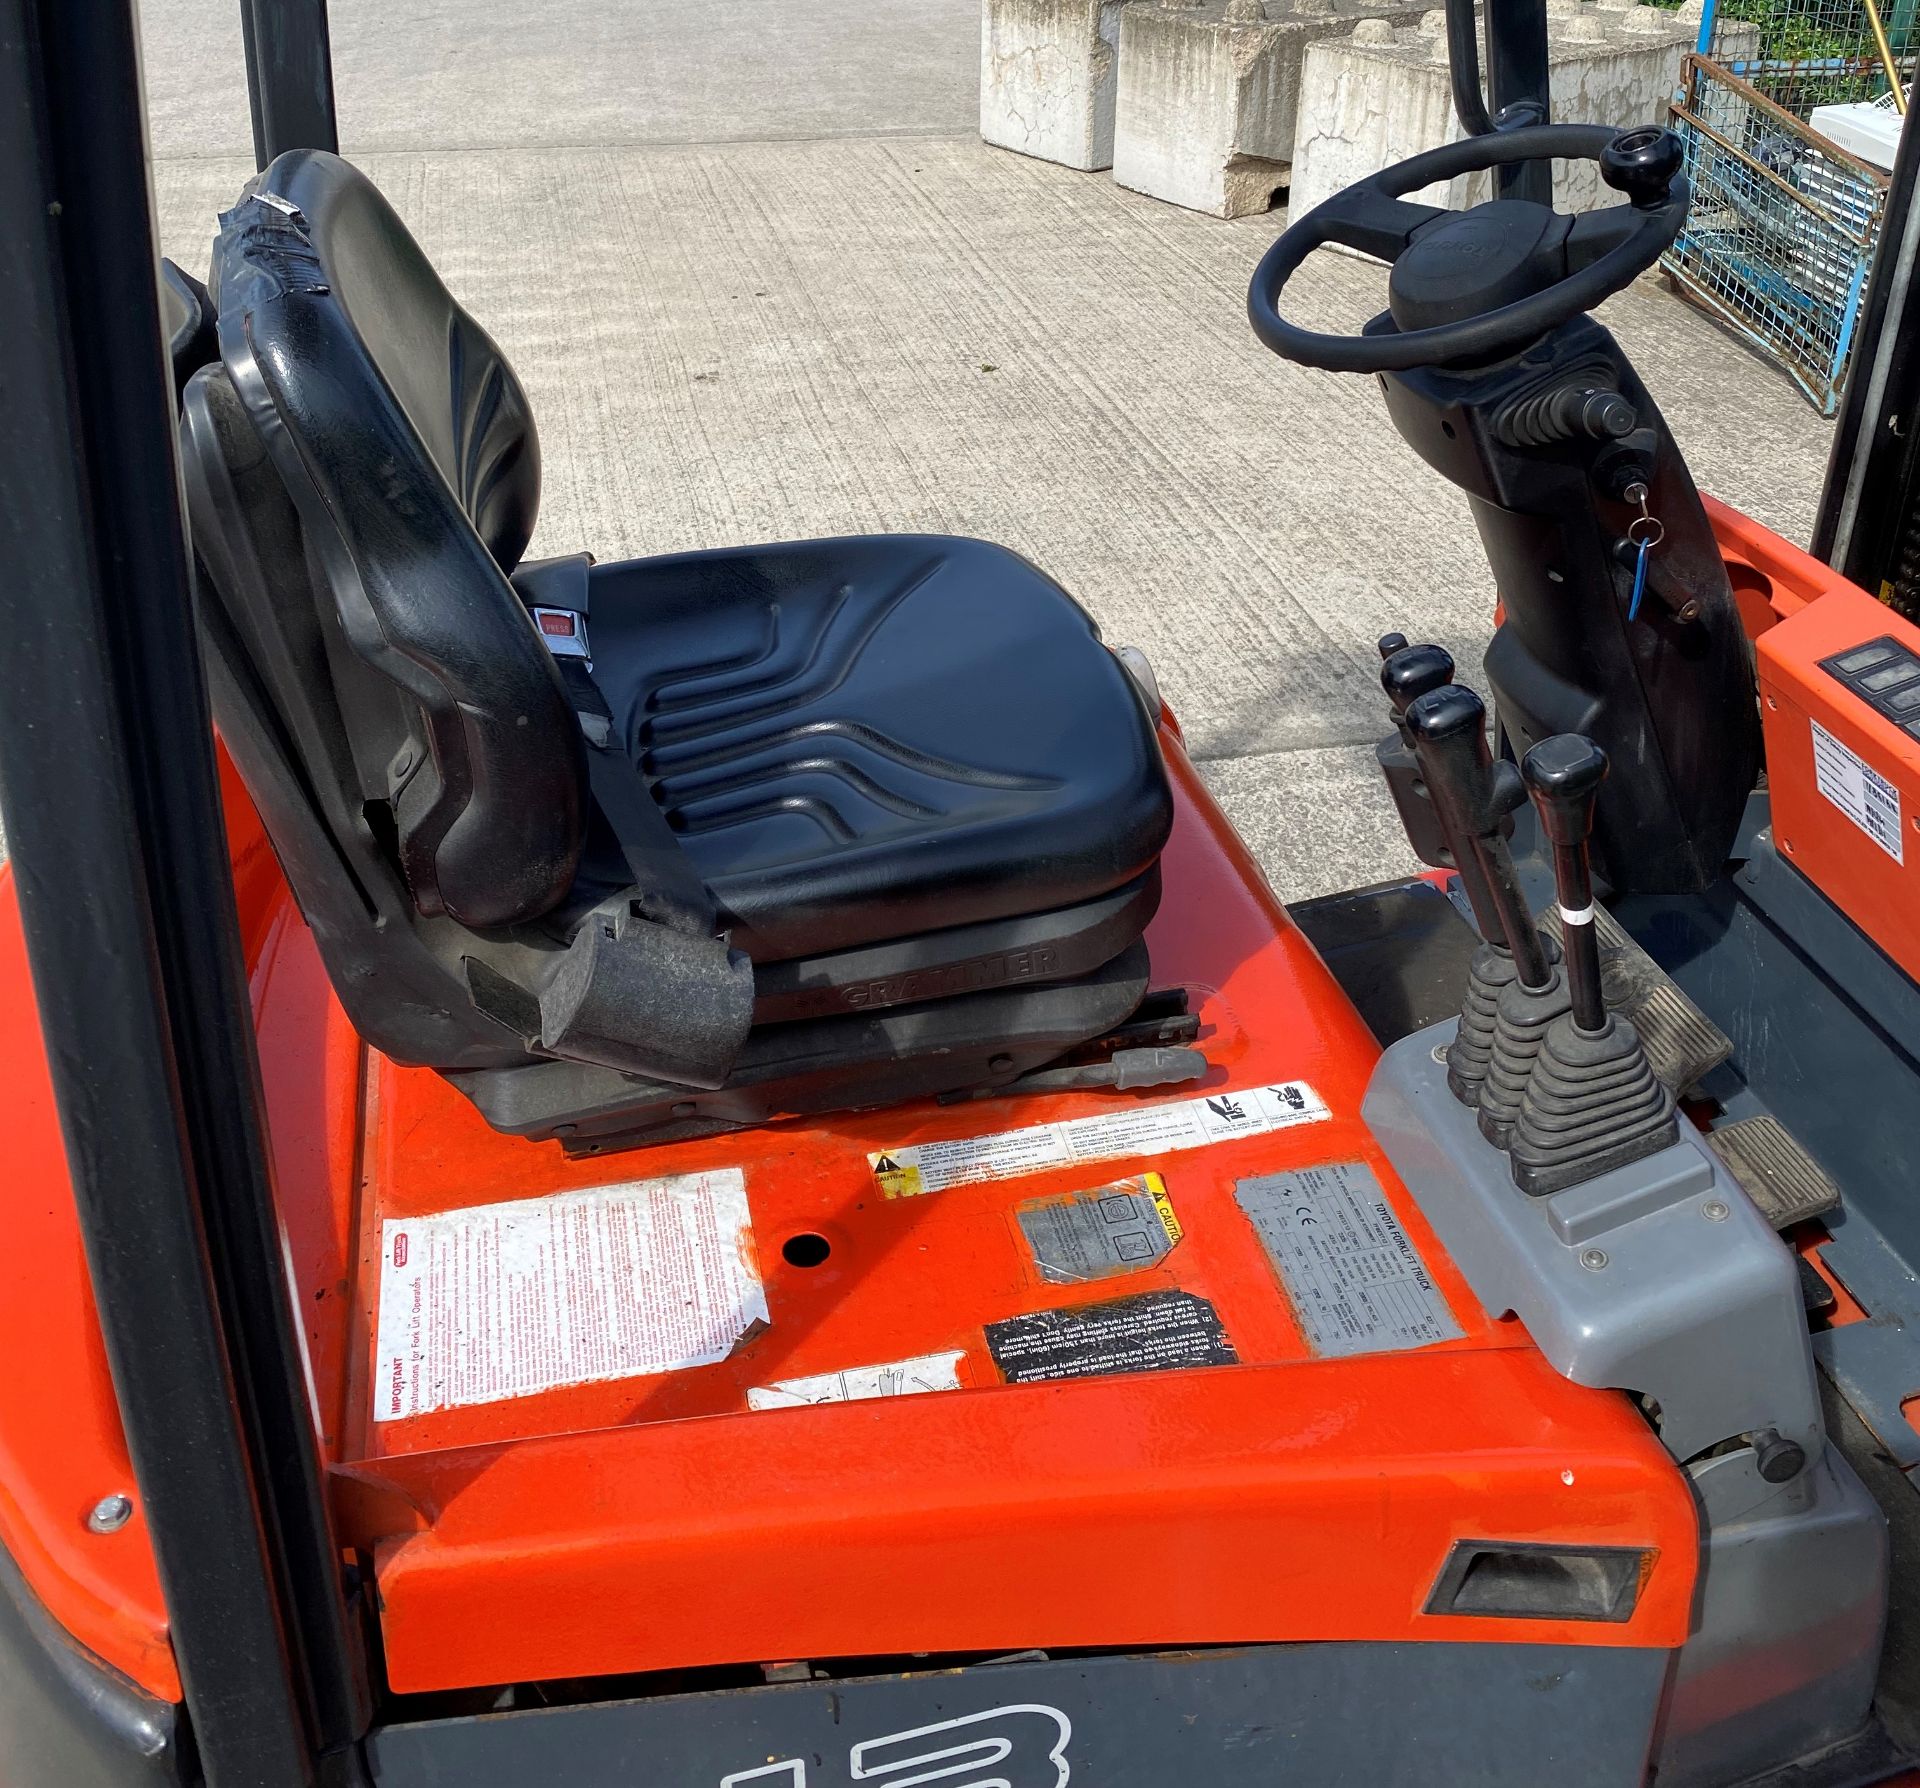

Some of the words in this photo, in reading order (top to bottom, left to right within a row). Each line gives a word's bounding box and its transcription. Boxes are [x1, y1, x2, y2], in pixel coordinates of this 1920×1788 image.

[1293, 1206, 1318, 1226] CE
[1373, 1203, 1396, 1230] TOYOTA
[1389, 1231, 1417, 1264] FORKLIFT
[1410, 1266, 1433, 1291] TRUCK
[411, 1276, 422, 1313] Operators
[411, 1315, 420, 1328] Lift
[1108, 1322, 1140, 1331] Careless
[1146, 1324, 1166, 1332] forks
[411, 1331, 420, 1348] Fork
[1176, 1331, 1207, 1339] between
[1190, 1337, 1209, 1345] forks
[998, 1342, 1028, 1350] machine
[1189, 1343, 1211, 1351] When
[410, 1351, 420, 1361] for
[999, 1349, 1025, 1358] special
[1127, 1349, 1142, 1357] that
[1166, 1348, 1183, 1357] load
[1057, 1357, 1088, 1368] properly
[1097, 1354, 1114, 1362] load
[1123, 1356, 1142, 1364] forks
[1089, 1361, 1114, 1370] shifted
[391, 1356, 403, 1414] IMPORTANT
[409, 1364, 419, 1411] Instructions
